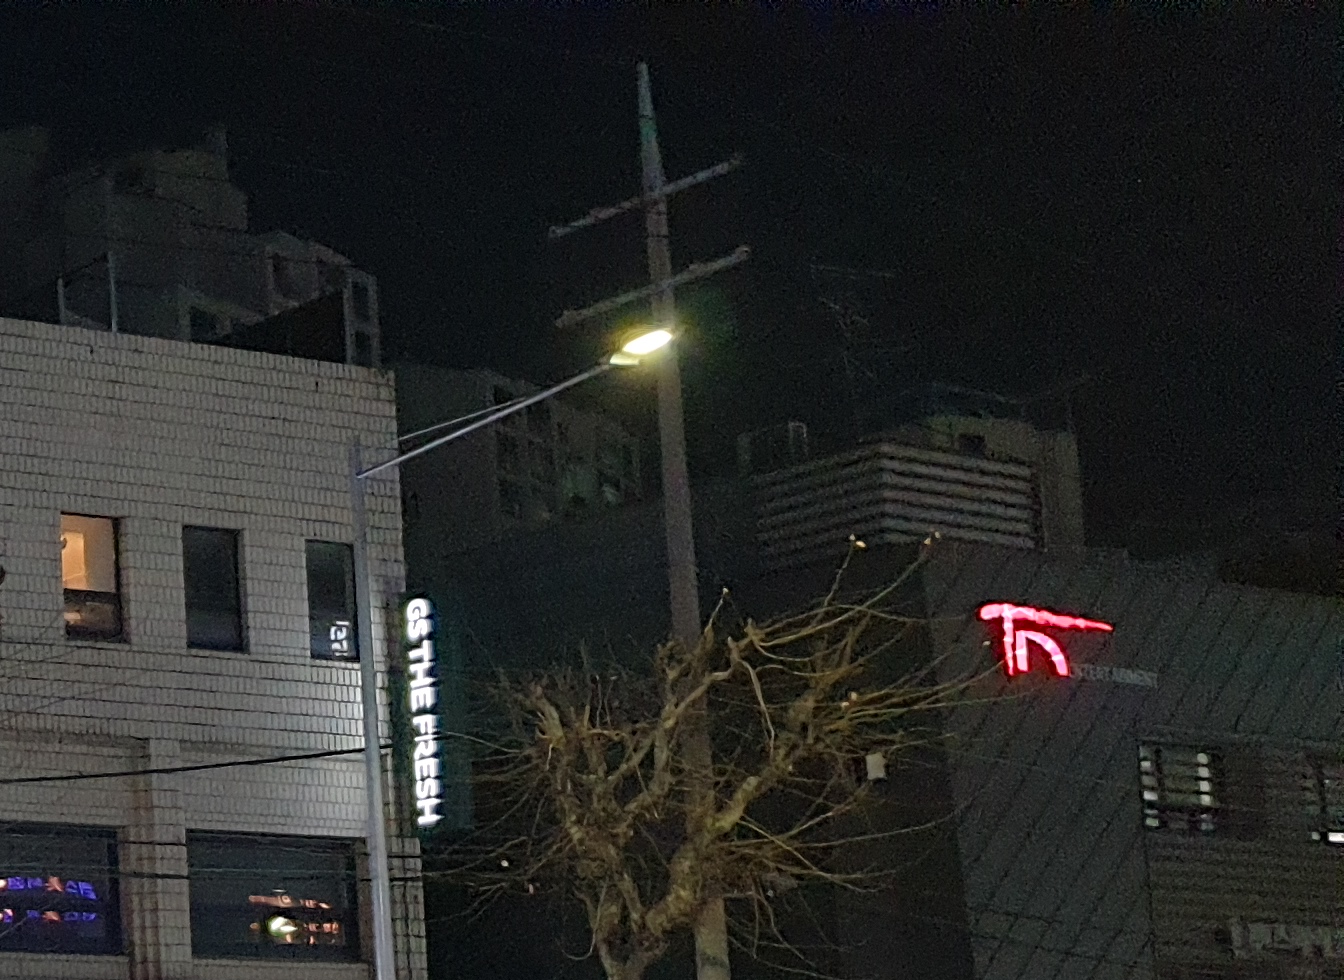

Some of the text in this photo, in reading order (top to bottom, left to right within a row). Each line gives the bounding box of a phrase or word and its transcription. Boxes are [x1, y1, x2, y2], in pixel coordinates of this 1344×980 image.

[406, 598, 445, 828] GS THE FRESH
